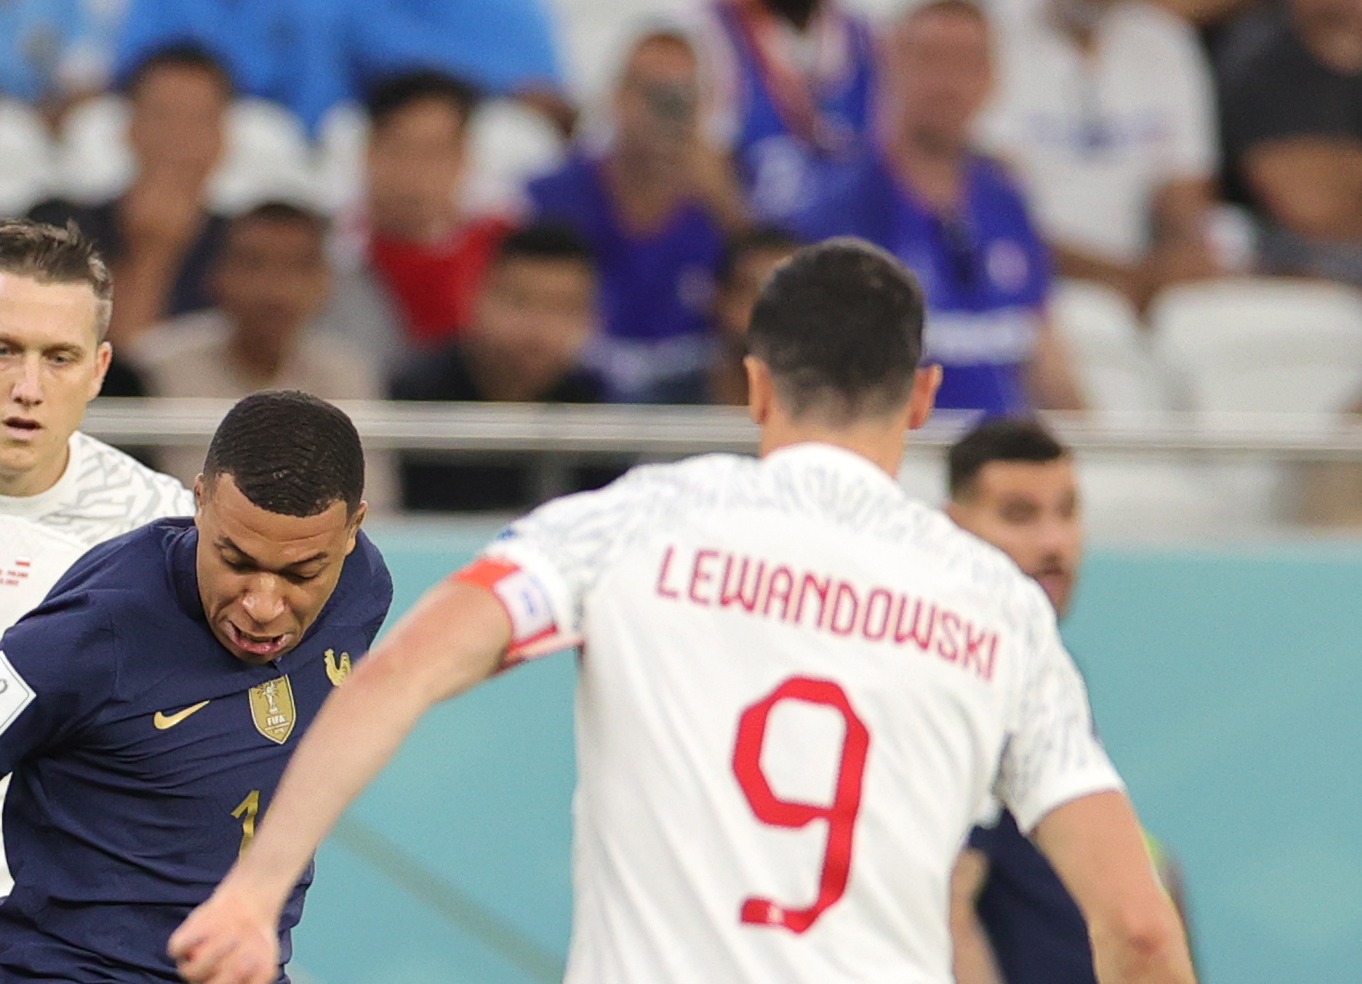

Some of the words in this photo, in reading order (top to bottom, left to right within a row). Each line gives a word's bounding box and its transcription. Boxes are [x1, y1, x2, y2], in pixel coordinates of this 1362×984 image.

[655, 545, 1001, 683] LEWANDOWSKI
[267, 714, 285, 726] FIFA
[230, 790, 260, 860] 1
[731, 673, 871, 936] 9
